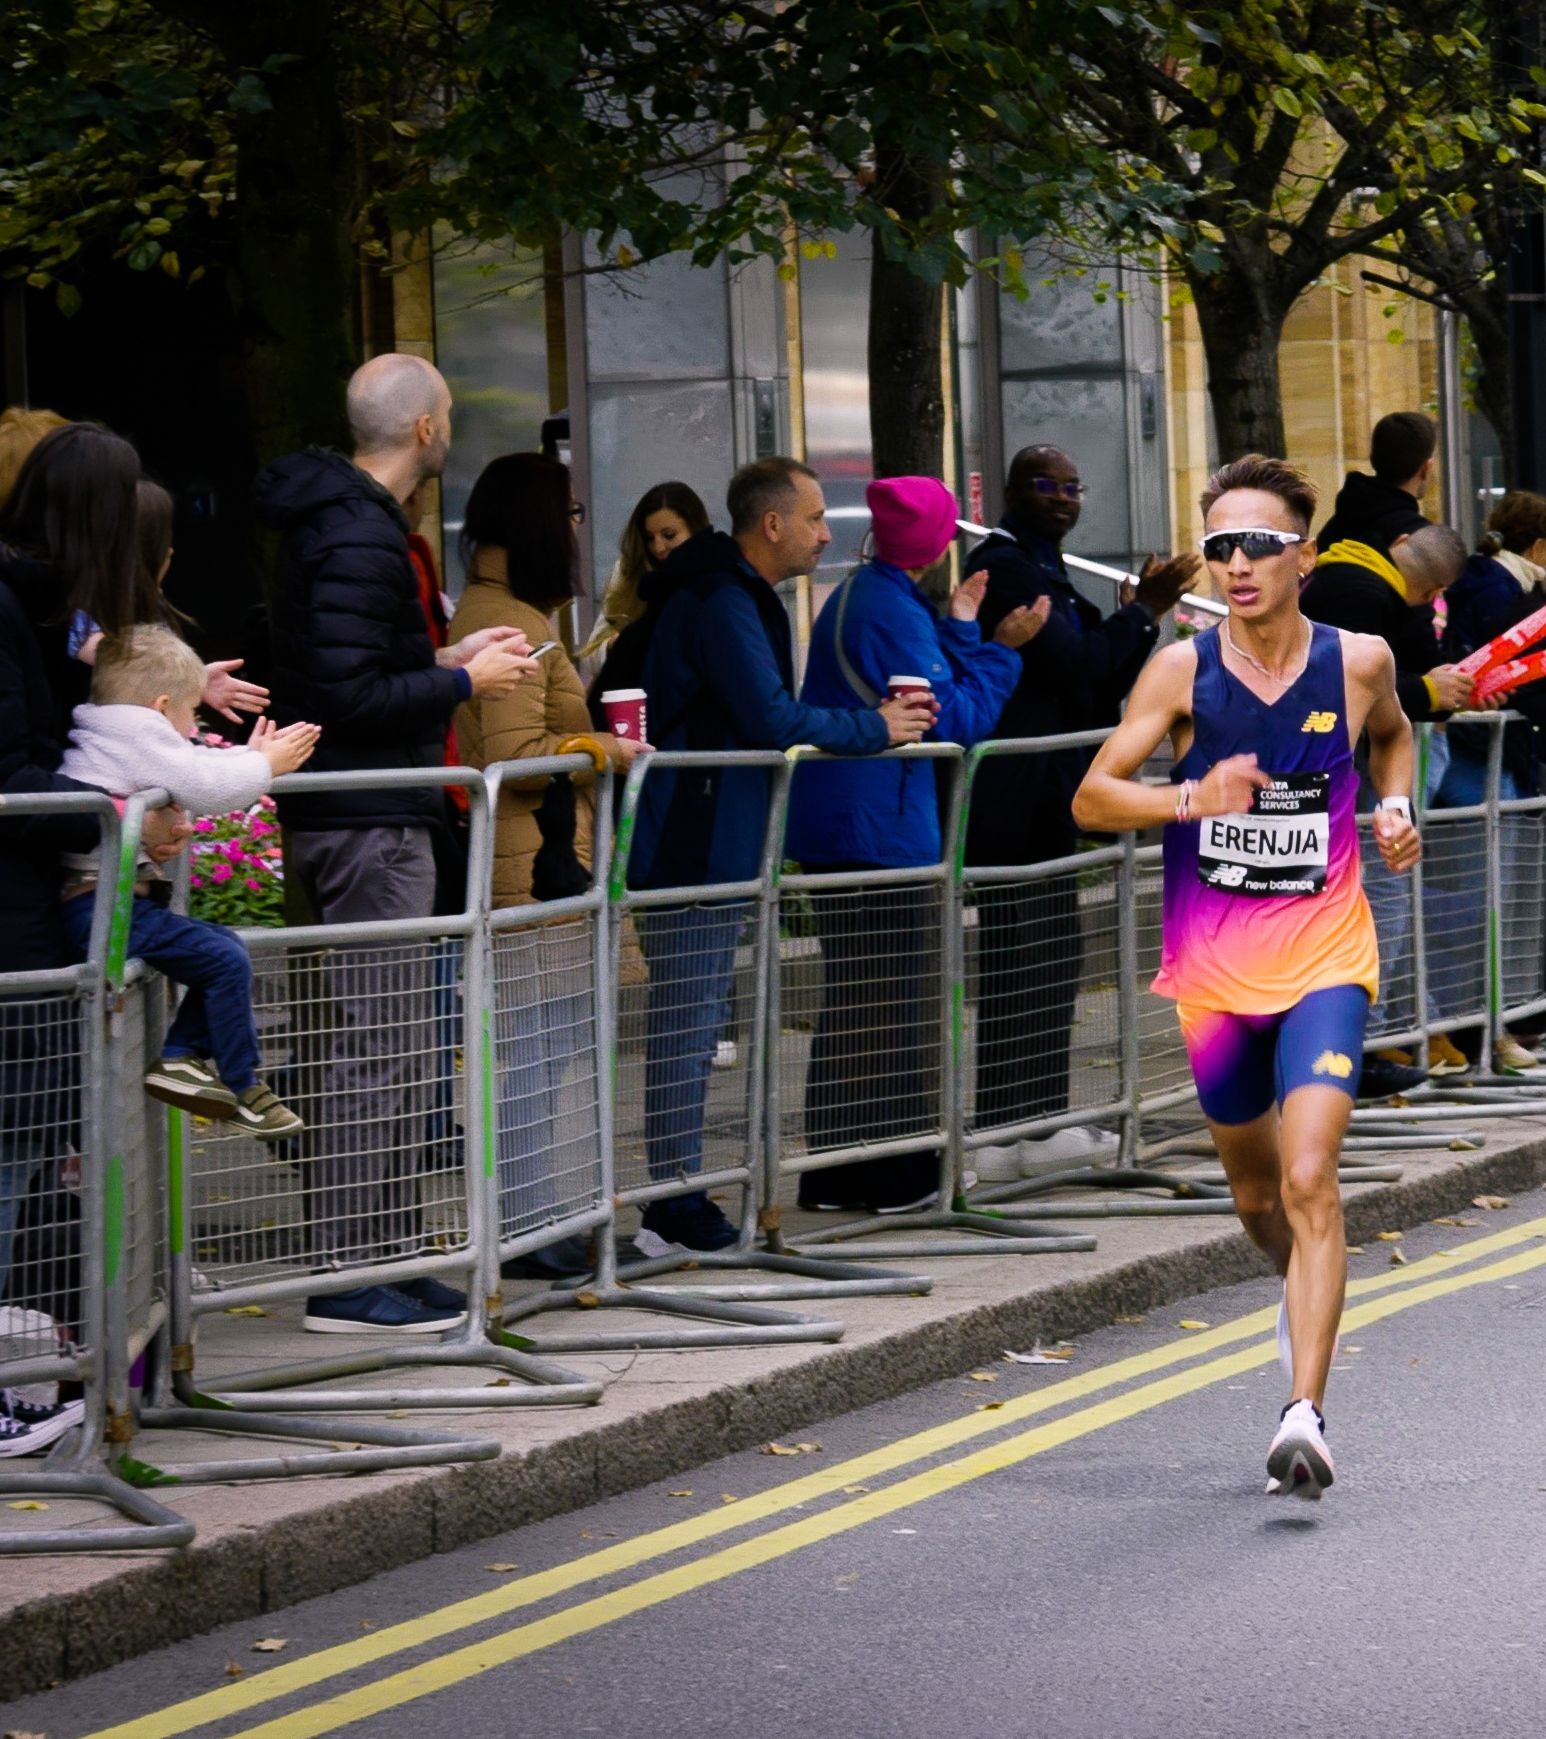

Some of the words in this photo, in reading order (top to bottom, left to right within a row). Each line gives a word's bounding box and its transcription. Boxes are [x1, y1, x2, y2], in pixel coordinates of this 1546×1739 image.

[1260, 789, 1321, 800] CONSULTANCY
[1260, 800, 1300, 810] SERVICES
[1210, 820, 1319, 856] ERENJIA
[1245, 880, 1268, 890] new
[1269, 879, 1315, 891] balance
